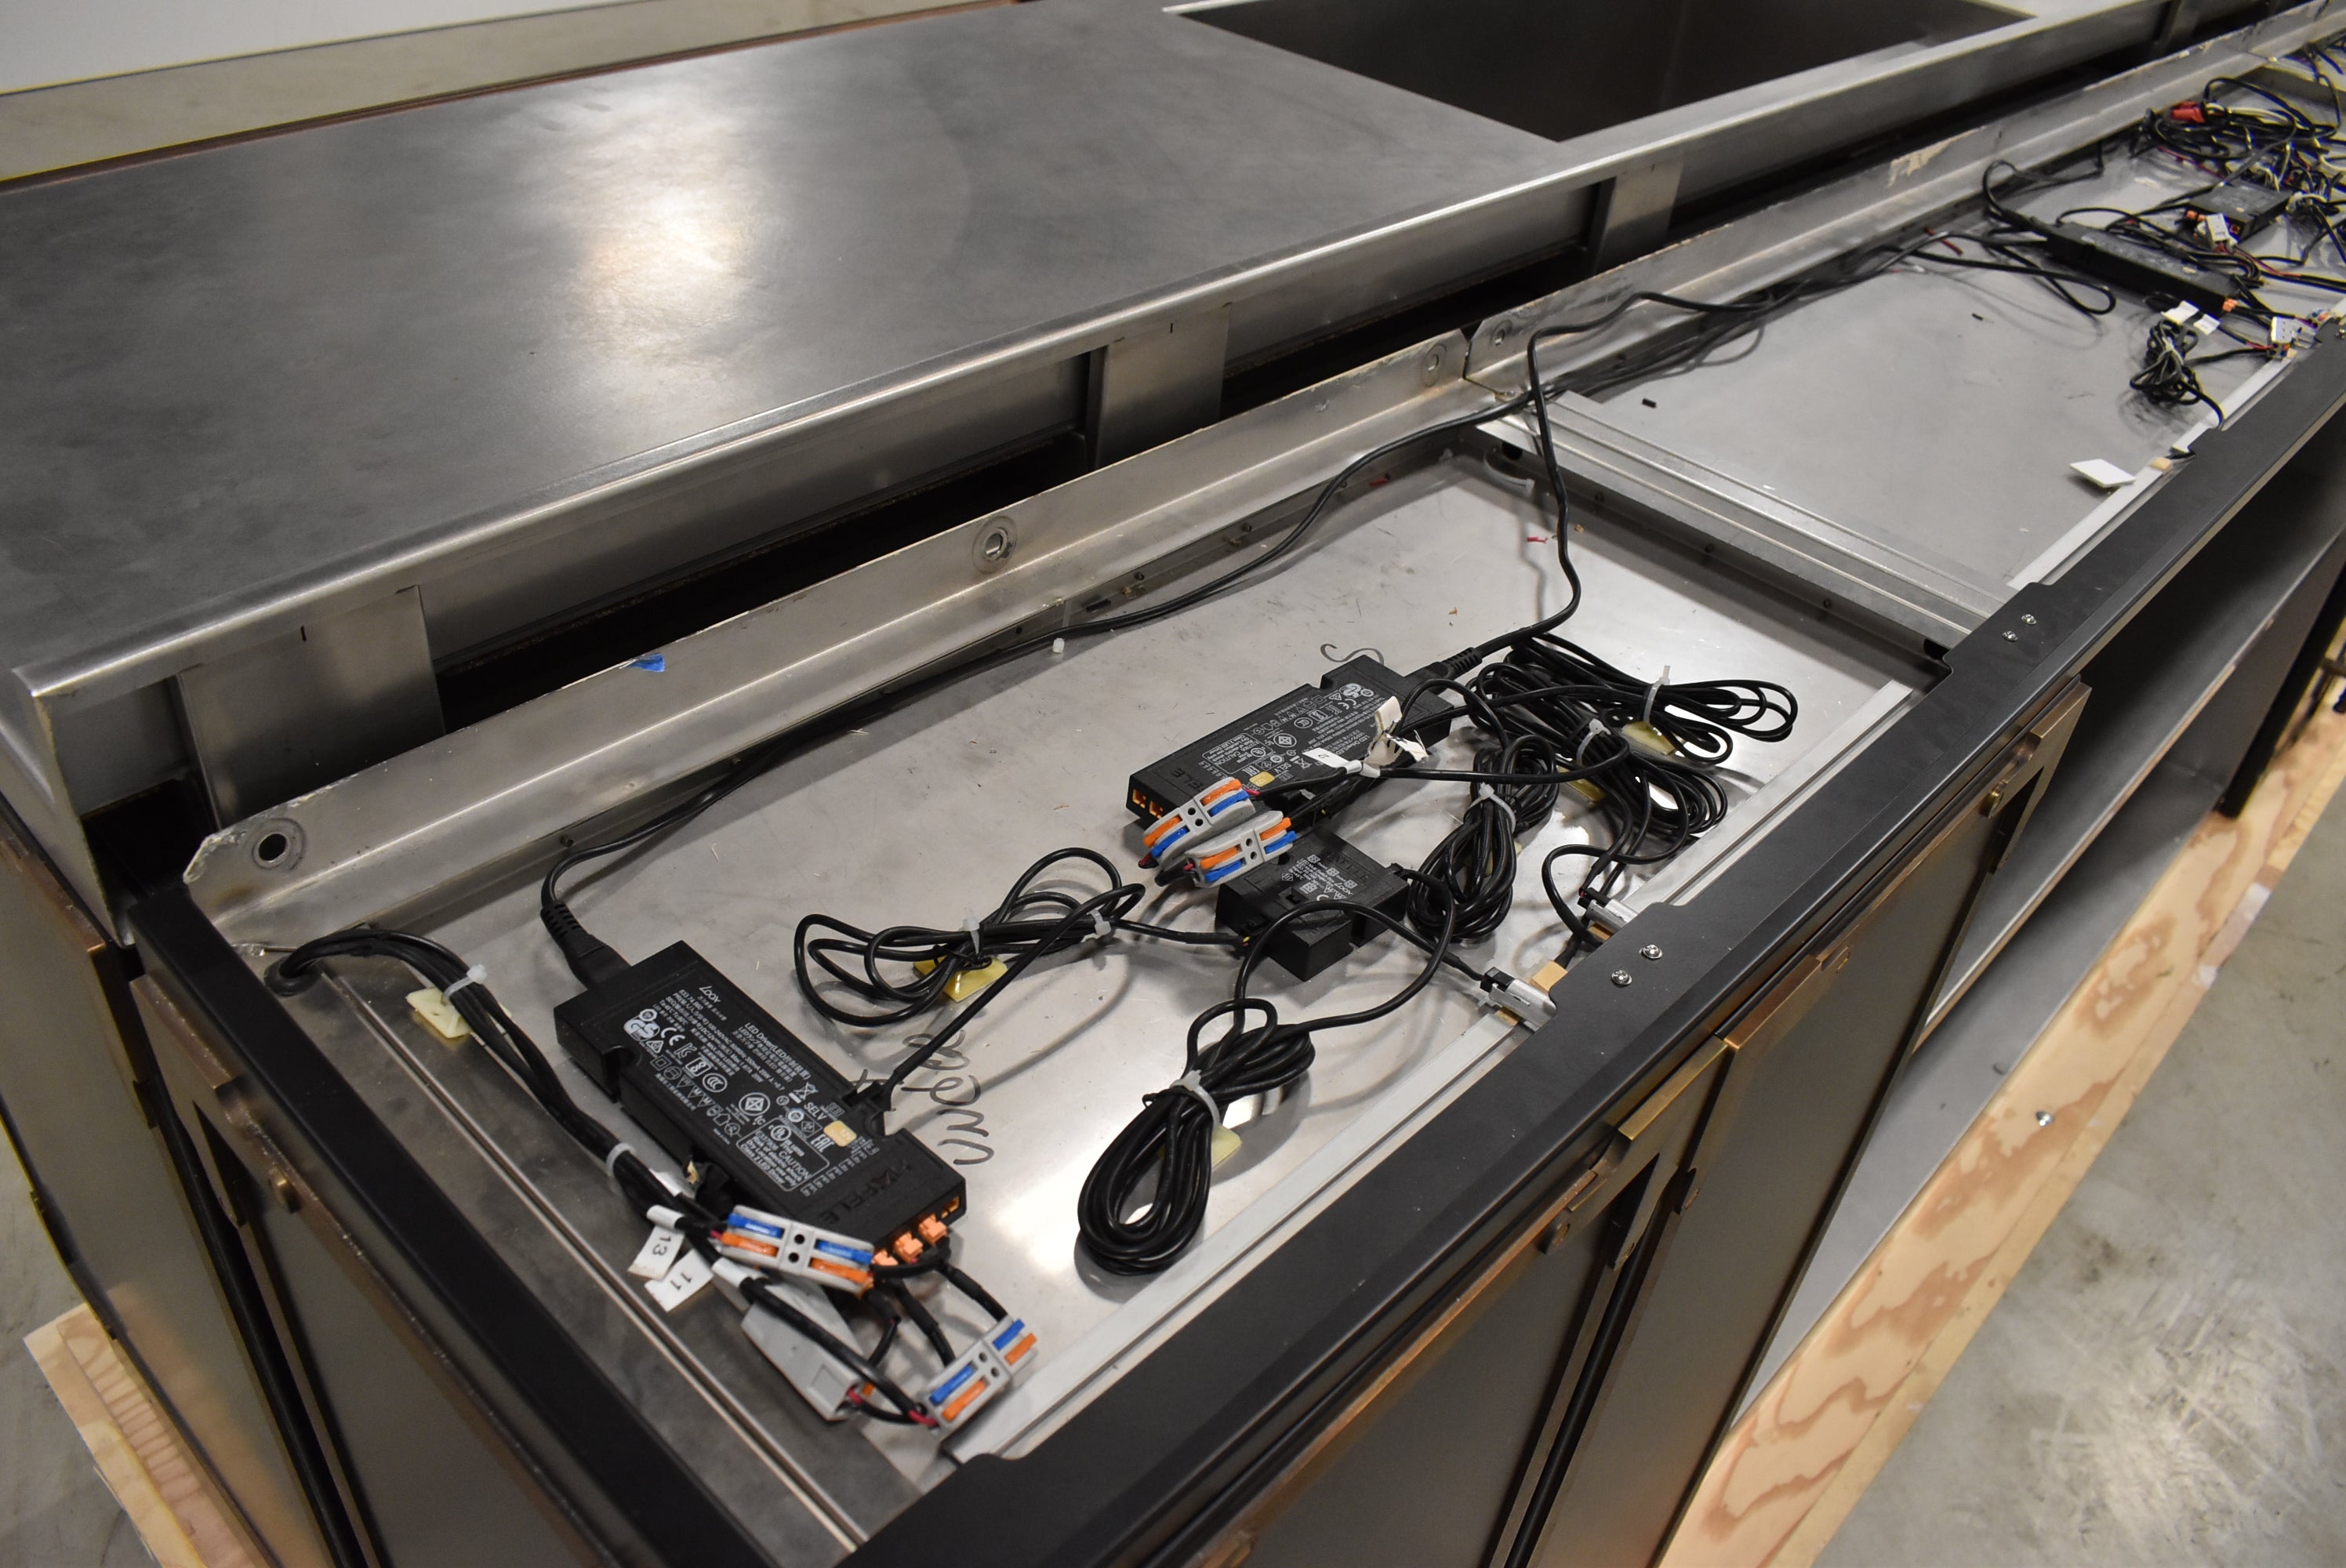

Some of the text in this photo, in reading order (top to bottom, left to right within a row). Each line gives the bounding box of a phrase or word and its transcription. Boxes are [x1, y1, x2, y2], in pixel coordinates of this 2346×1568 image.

[1224, 741, 1242, 750] Location
[1214, 751, 1240, 766] CAUTION
[1274, 762, 1291, 773] SELV
[657, 1027, 685, 1046] CE
[744, 1022, 759, 1034] LED
[804, 1102, 826, 1120] SELV
[740, 1143, 755, 1157] Class
[757, 1159, 770, 1170] LED
[768, 1169, 784, 1184] Driver
[746, 1139, 797, 1188] Dry Location use only
[752, 1135, 764, 1147] Risk
[768, 1152, 786, 1168] electric
[786, 1167, 801, 1181] shock
[779, 1151, 810, 1179] CAUTION
[652, 1236, 672, 1256] 13
[670, 1272, 693, 1291] 11
